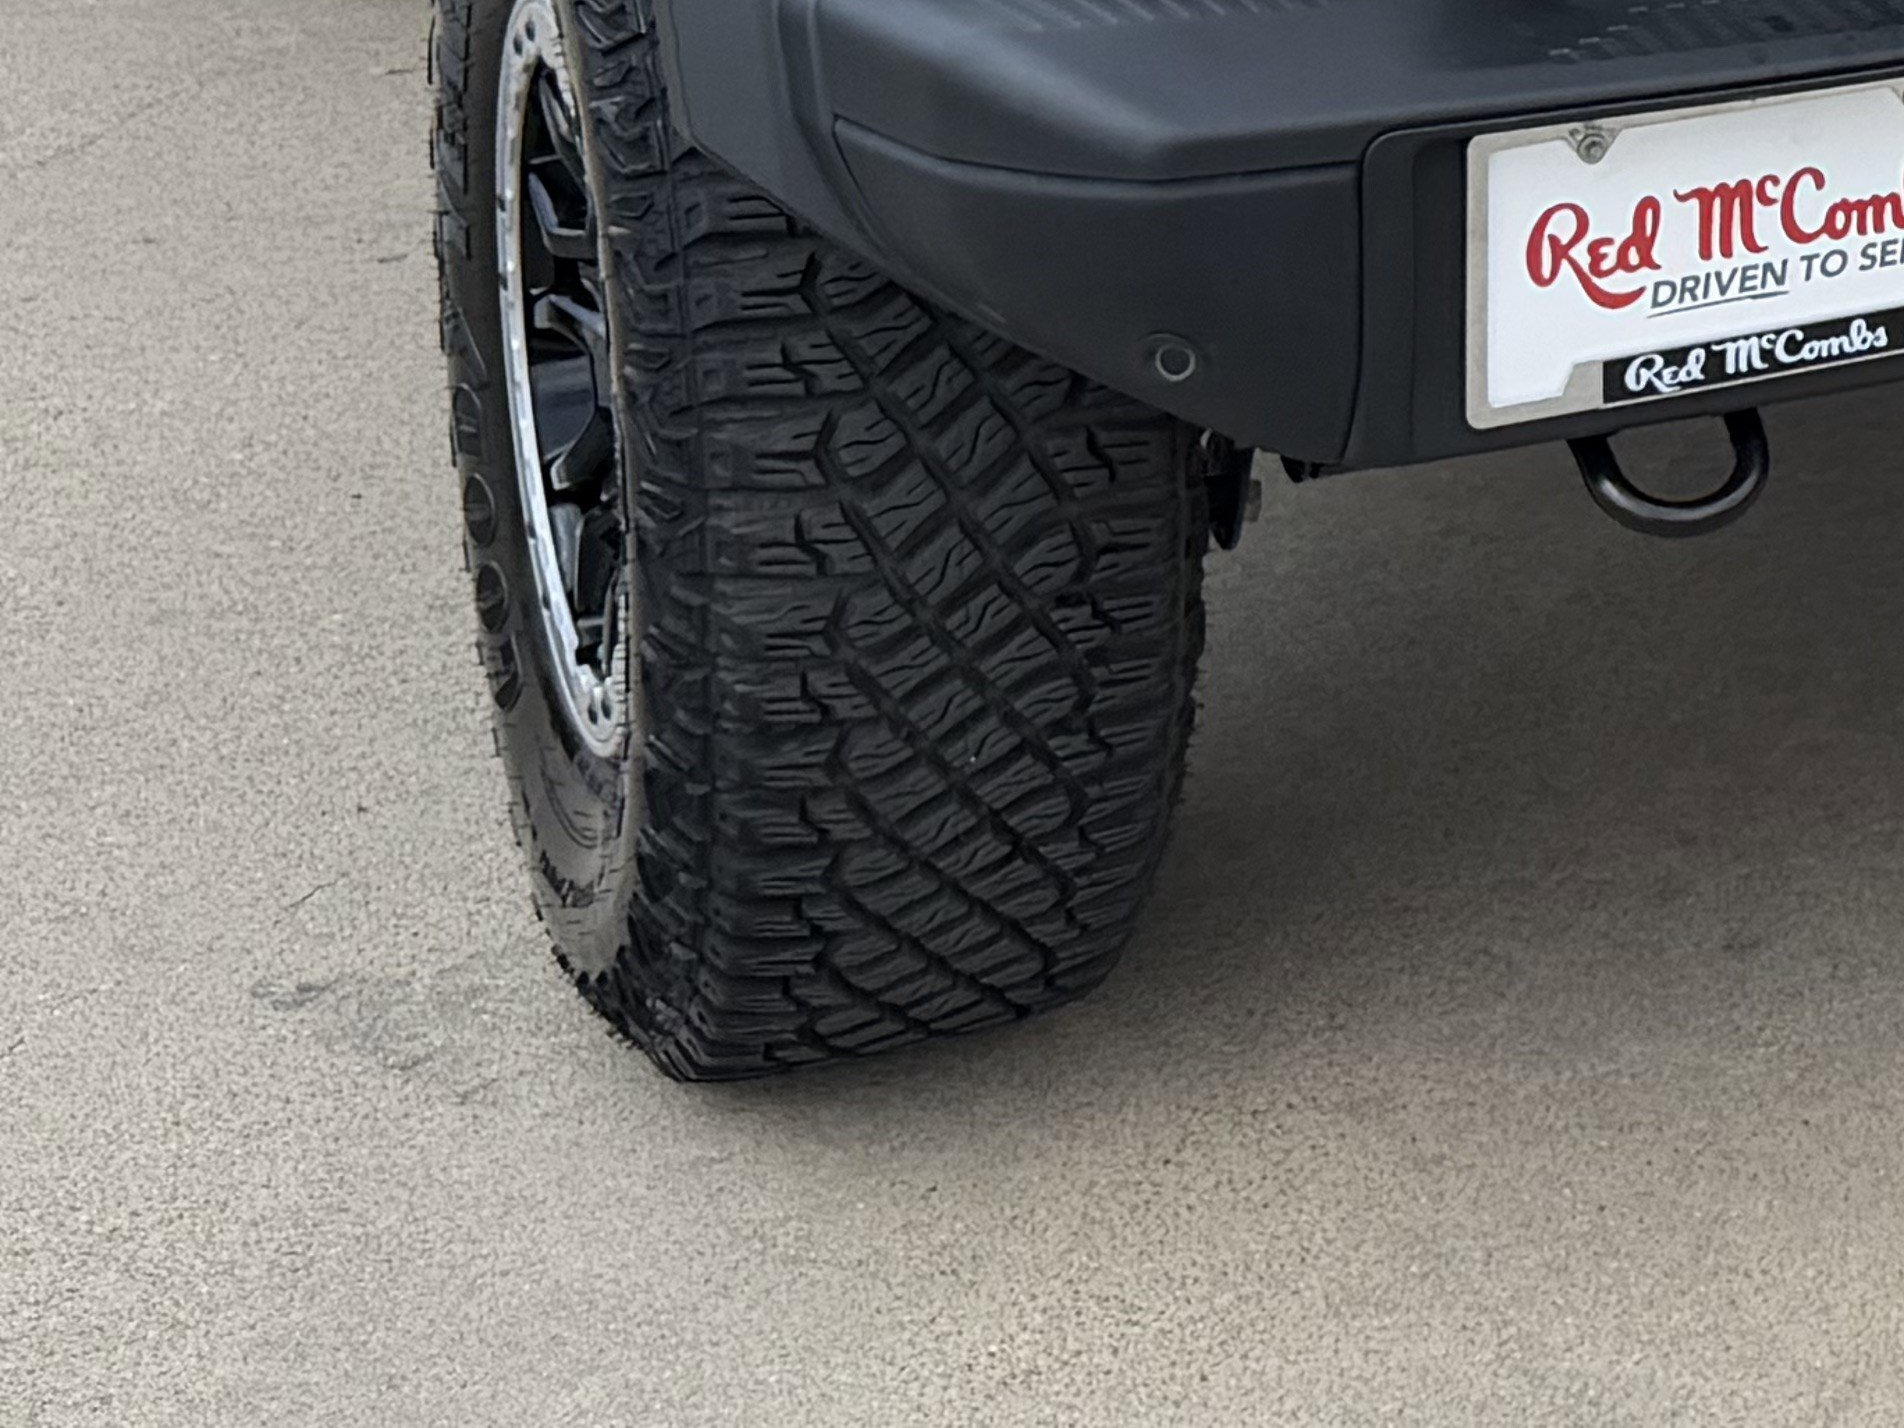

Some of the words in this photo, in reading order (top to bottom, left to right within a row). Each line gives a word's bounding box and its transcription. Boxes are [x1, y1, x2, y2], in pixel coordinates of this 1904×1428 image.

[1526, 196, 1661, 309] Red
[1651, 259, 1788, 309] DRIVEN
[1800, 249, 1848, 282] TO
[1624, 350, 1707, 393] Red
[1710, 318, 1888, 375] McCombs
